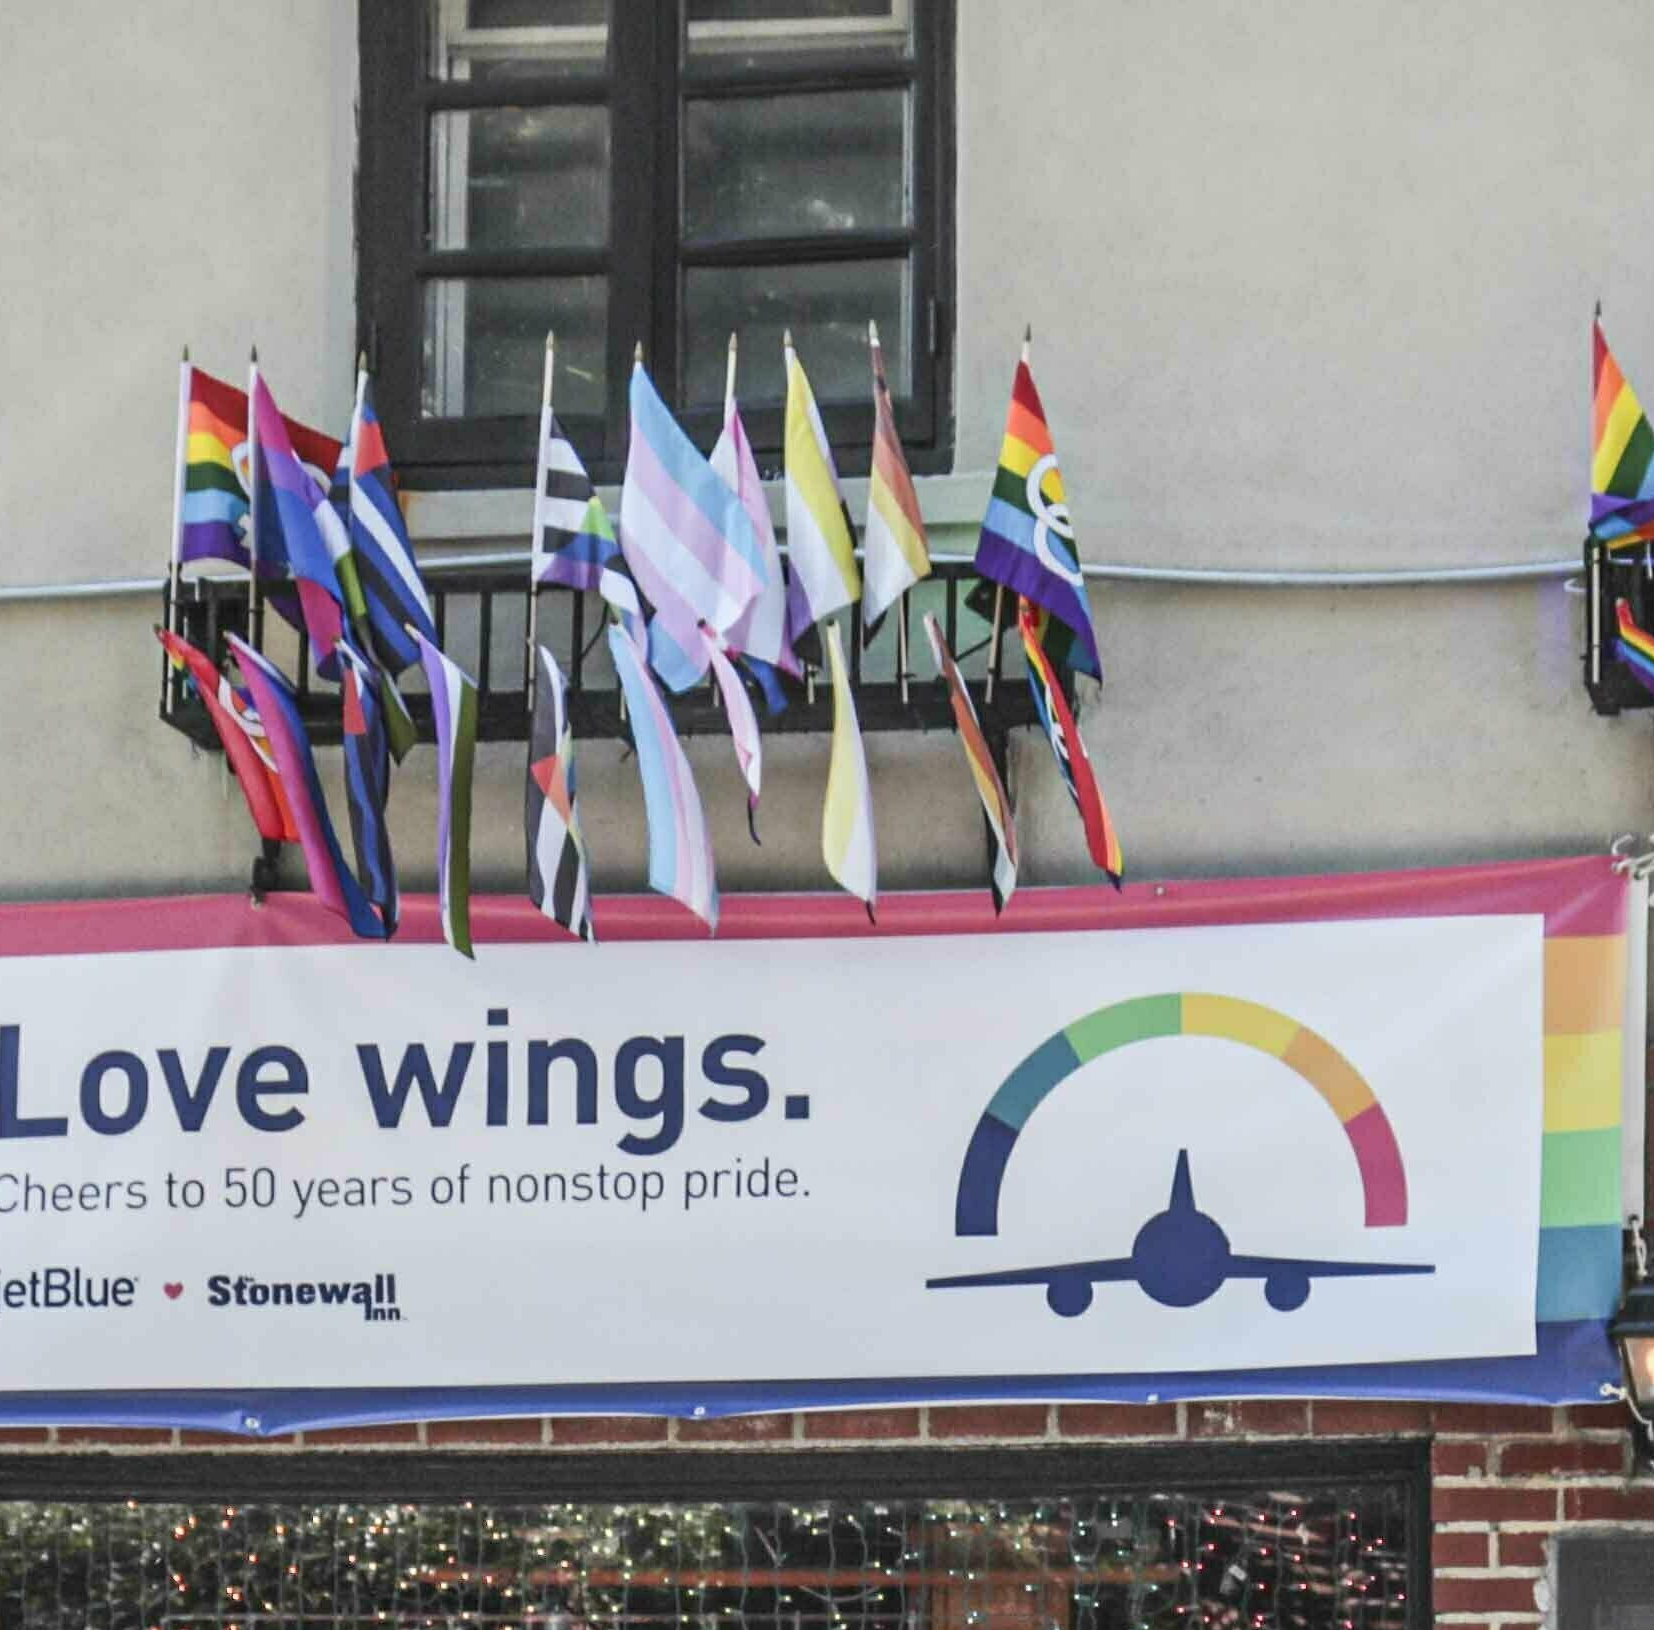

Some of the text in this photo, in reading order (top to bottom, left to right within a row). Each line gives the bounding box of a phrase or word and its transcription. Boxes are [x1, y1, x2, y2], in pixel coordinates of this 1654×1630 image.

[356, 1008, 810, 1156] wings.
[166, 1171, 205, 1208] to
[224, 1167, 276, 1208] 50
[292, 1172, 413, 1219] years
[430, 1163, 470, 1204] of
[489, 1164, 664, 1211] nonstop
[684, 1157, 810, 1210] pride.
[207, 1274, 396, 1307] Stonewall
[364, 1303, 402, 1321] Inn
